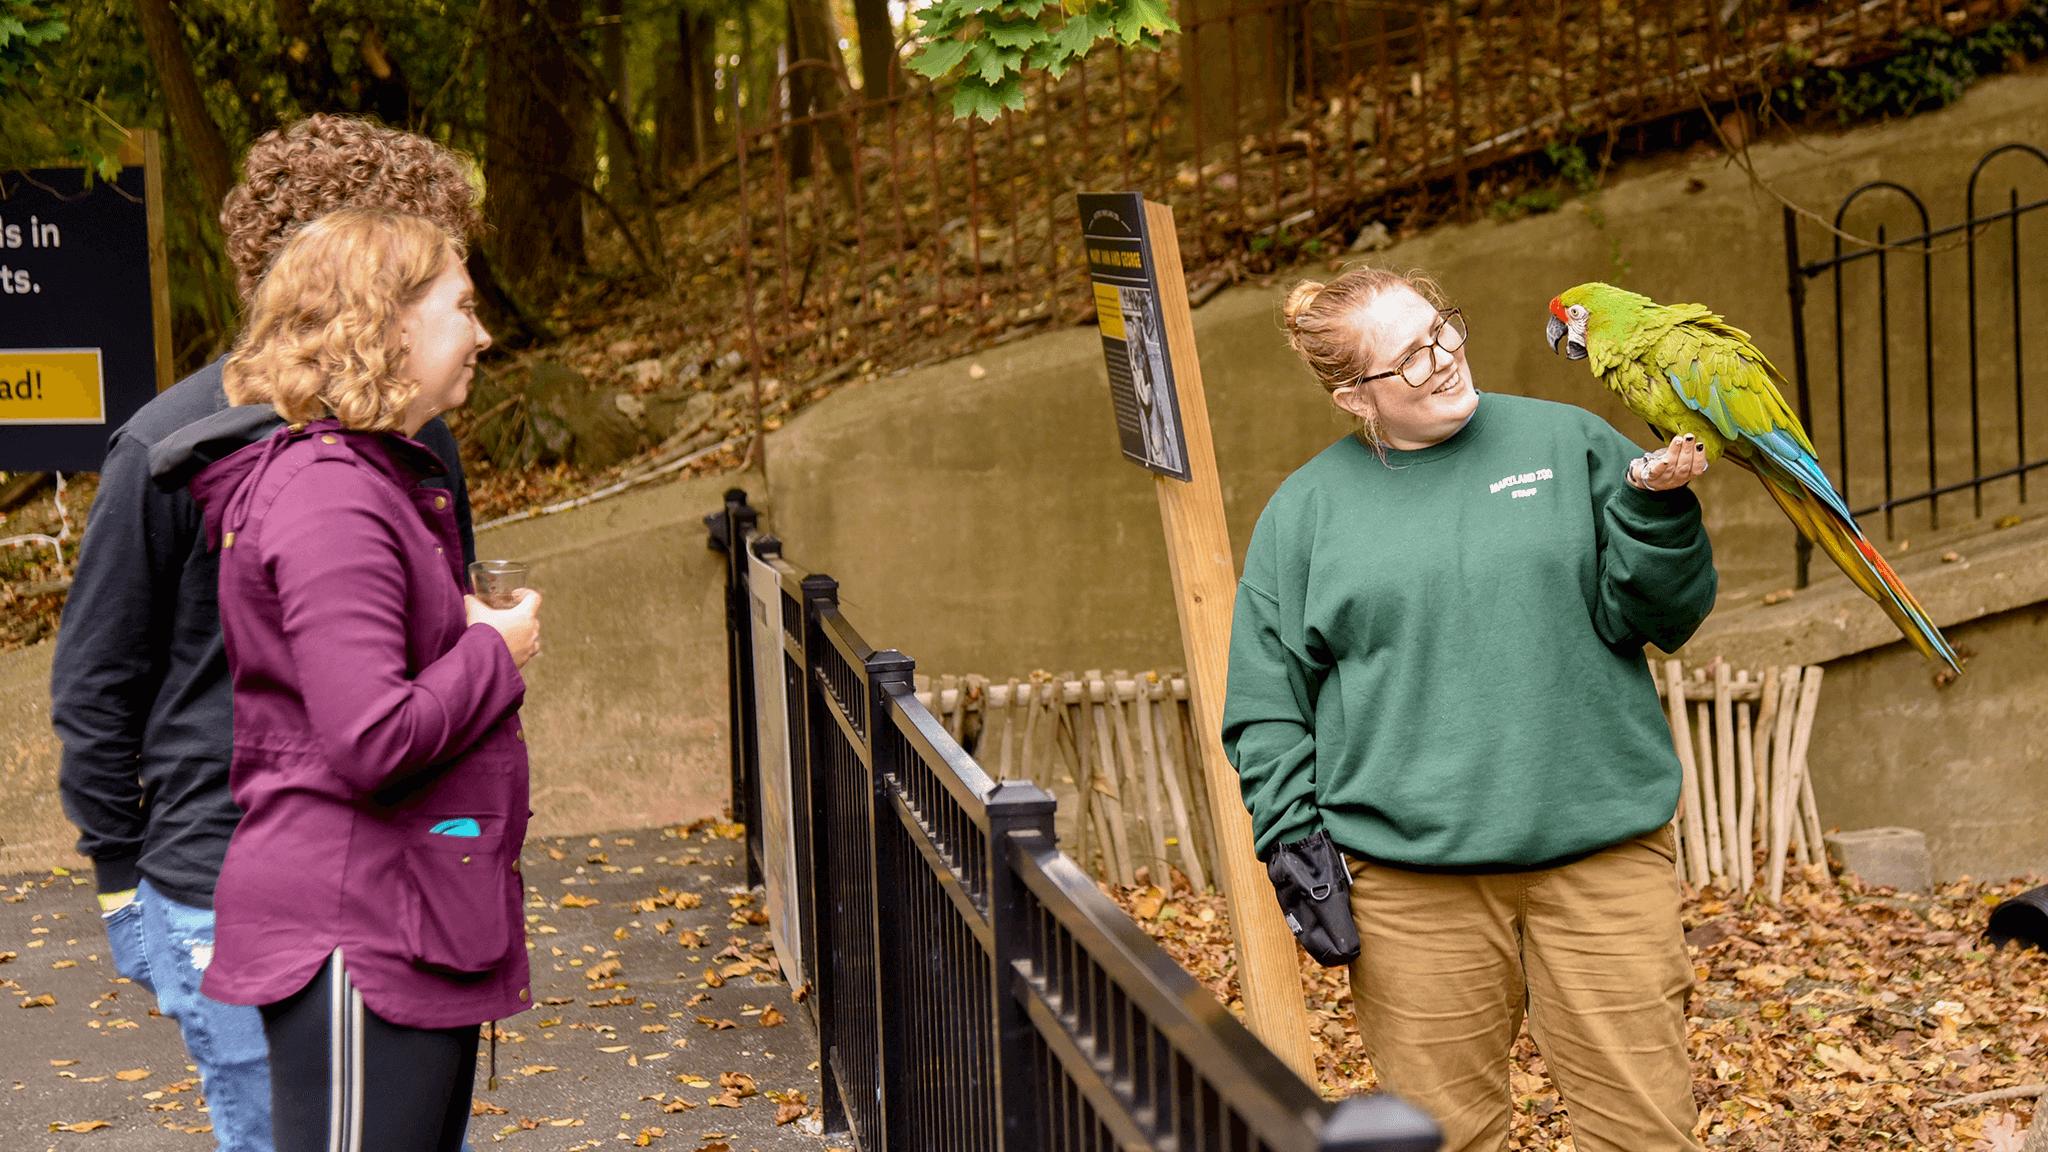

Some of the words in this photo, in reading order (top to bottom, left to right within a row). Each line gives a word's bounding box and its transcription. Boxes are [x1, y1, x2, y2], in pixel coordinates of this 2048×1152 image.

[31, 215, 60, 248] in
[1489, 472, 1536, 494] MARYLAND
[1536, 469, 1553, 480] ZOO
[1511, 487, 1537, 499] STAFF
